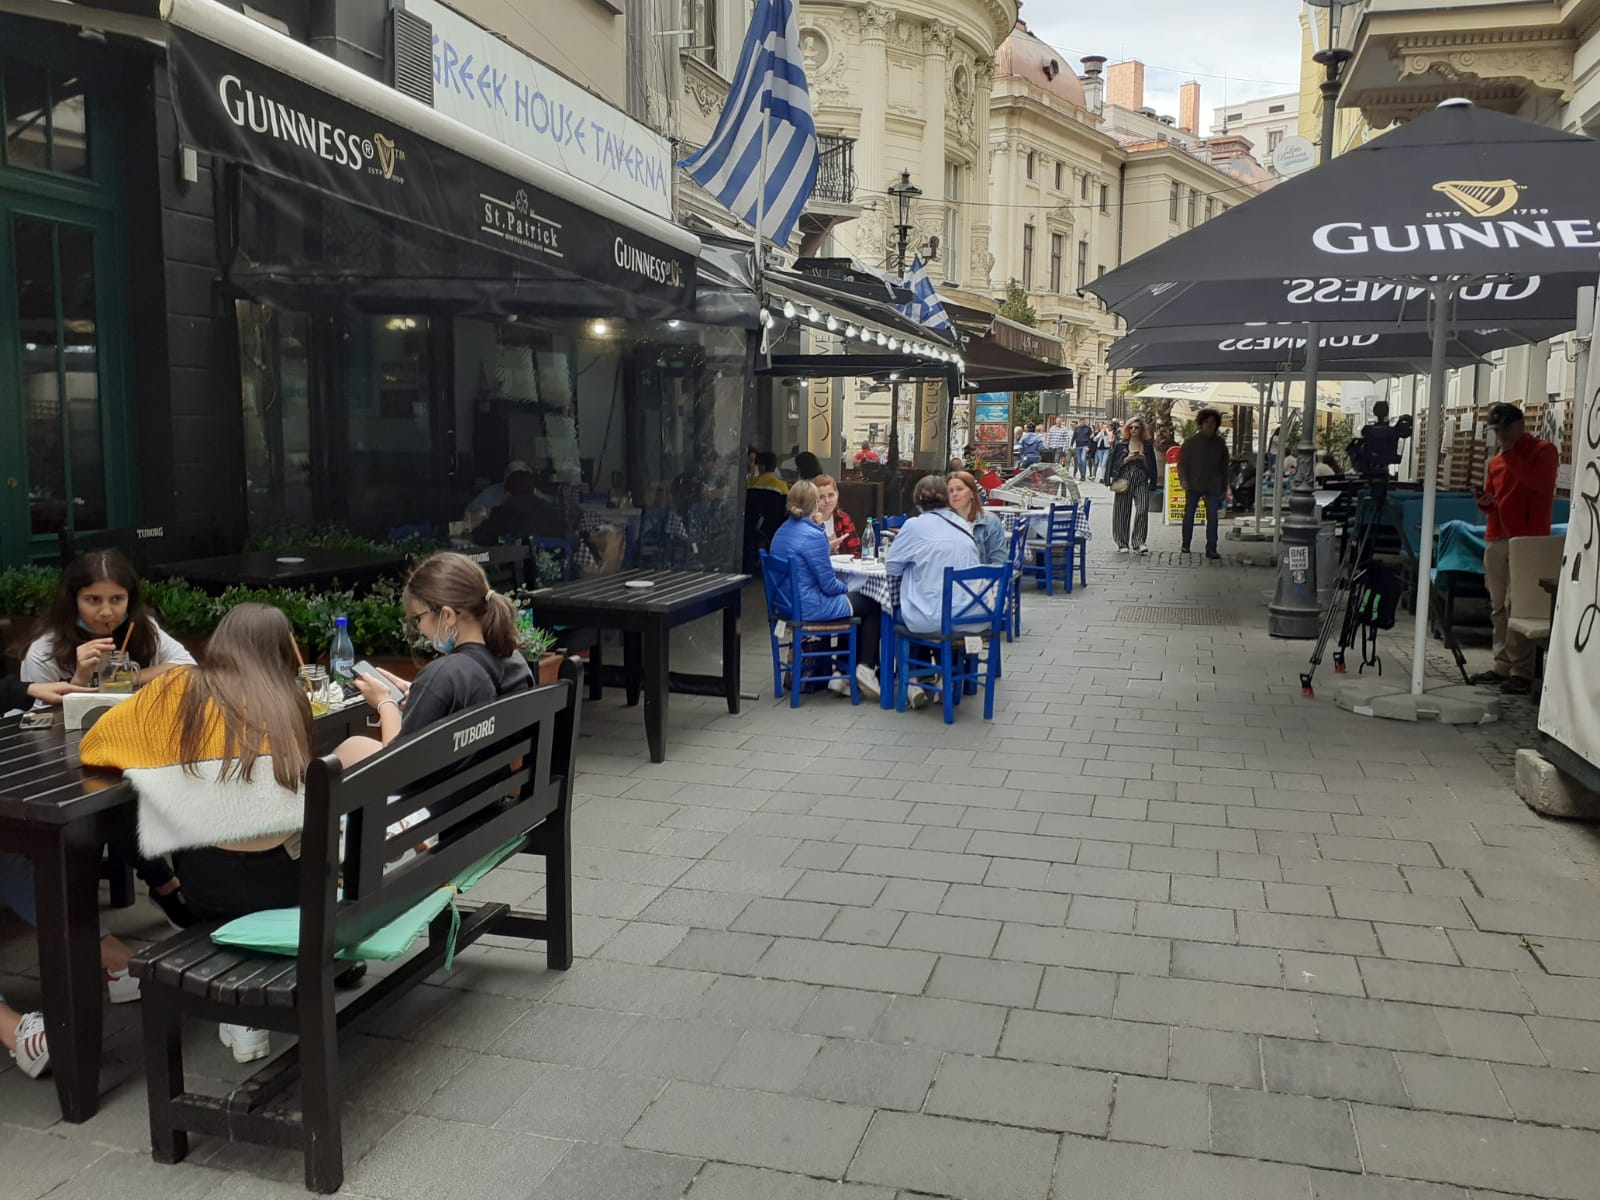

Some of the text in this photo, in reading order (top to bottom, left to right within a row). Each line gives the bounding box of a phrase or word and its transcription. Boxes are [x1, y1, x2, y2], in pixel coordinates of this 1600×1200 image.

[514, 79, 586, 156] HOUSE
[590, 121, 668, 197] TAVERNA
[453, 715, 496, 753] TUBORG
